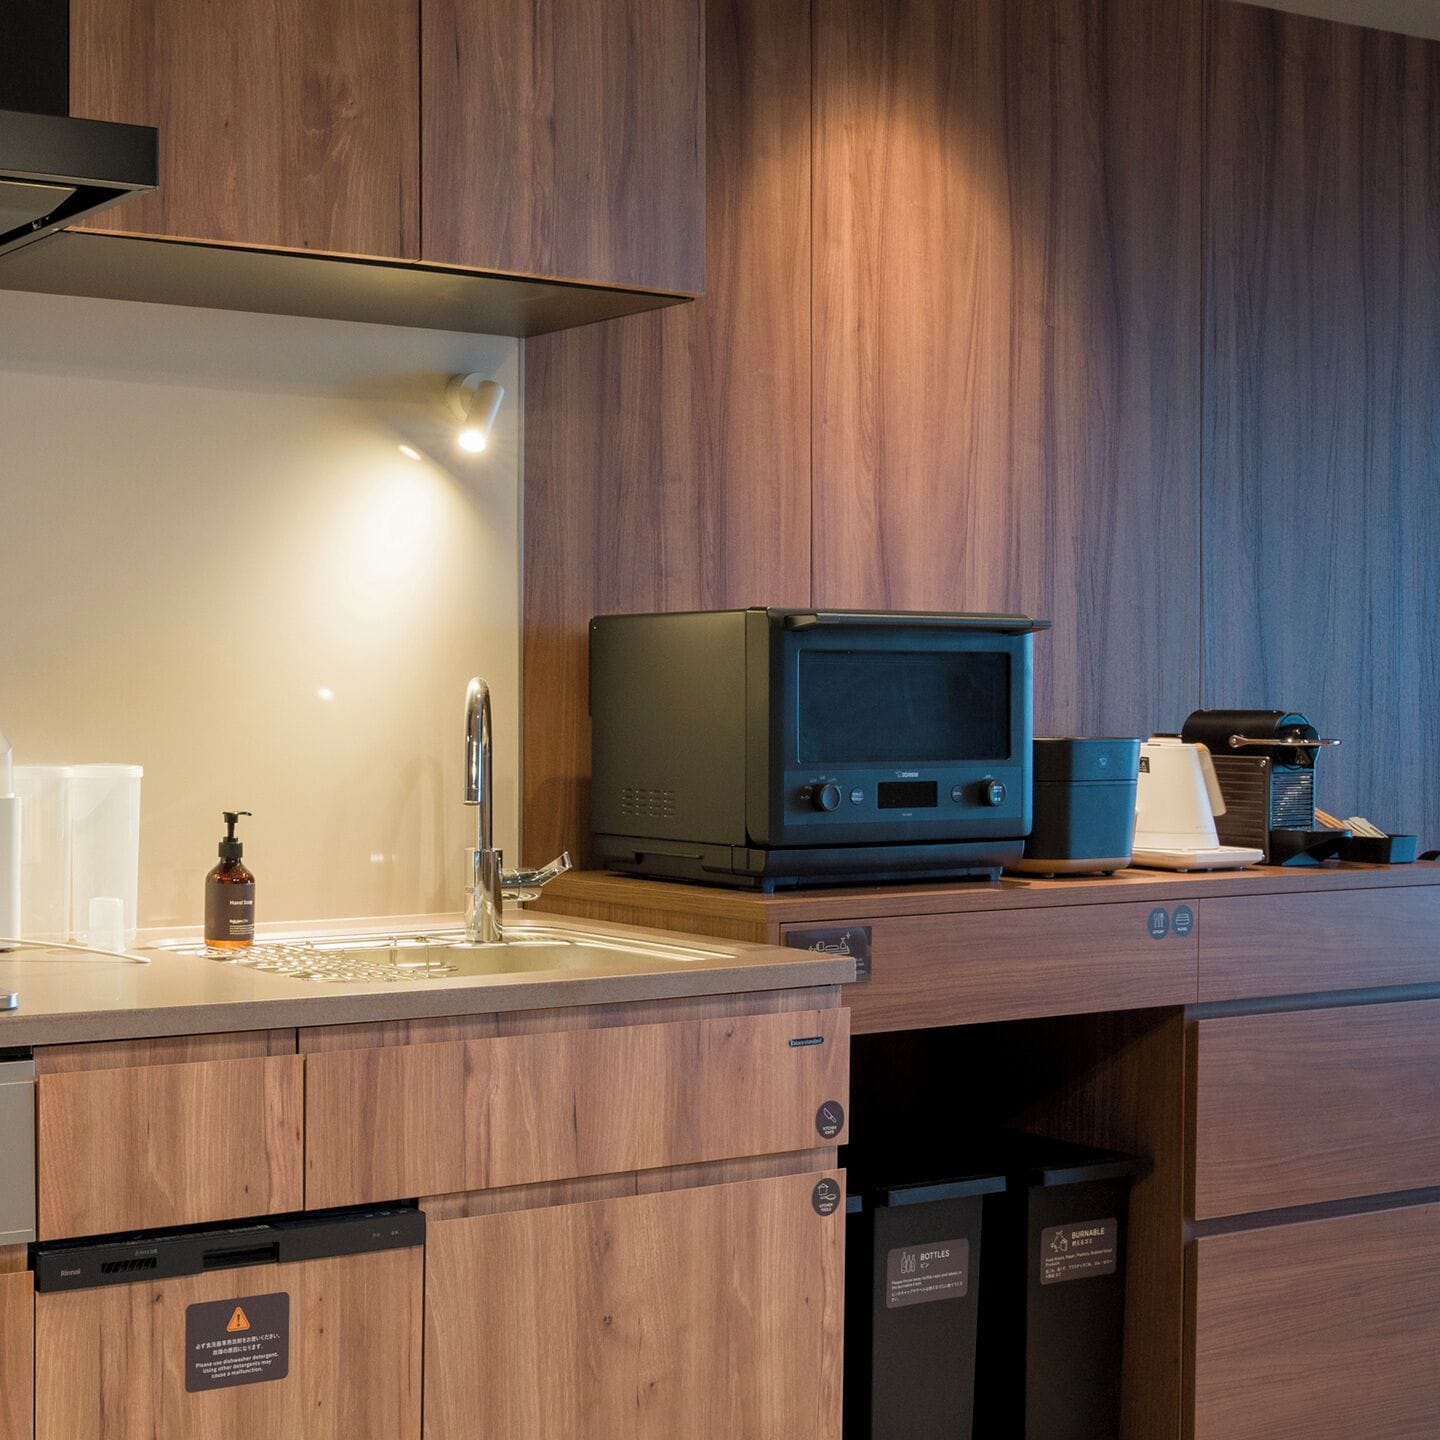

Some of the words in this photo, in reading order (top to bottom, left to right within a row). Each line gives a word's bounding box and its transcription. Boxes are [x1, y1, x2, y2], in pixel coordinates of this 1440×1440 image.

[1071, 1227, 1105, 1239] BURNABLE
[920, 1249, 950, 1261] BOTTLES
[60, 1268, 81, 1277] Rinnai
[223, 1356, 252, 1364] dishwasher
[202, 1366, 218, 1374] Using
[233, 1361, 261, 1369] detergents
